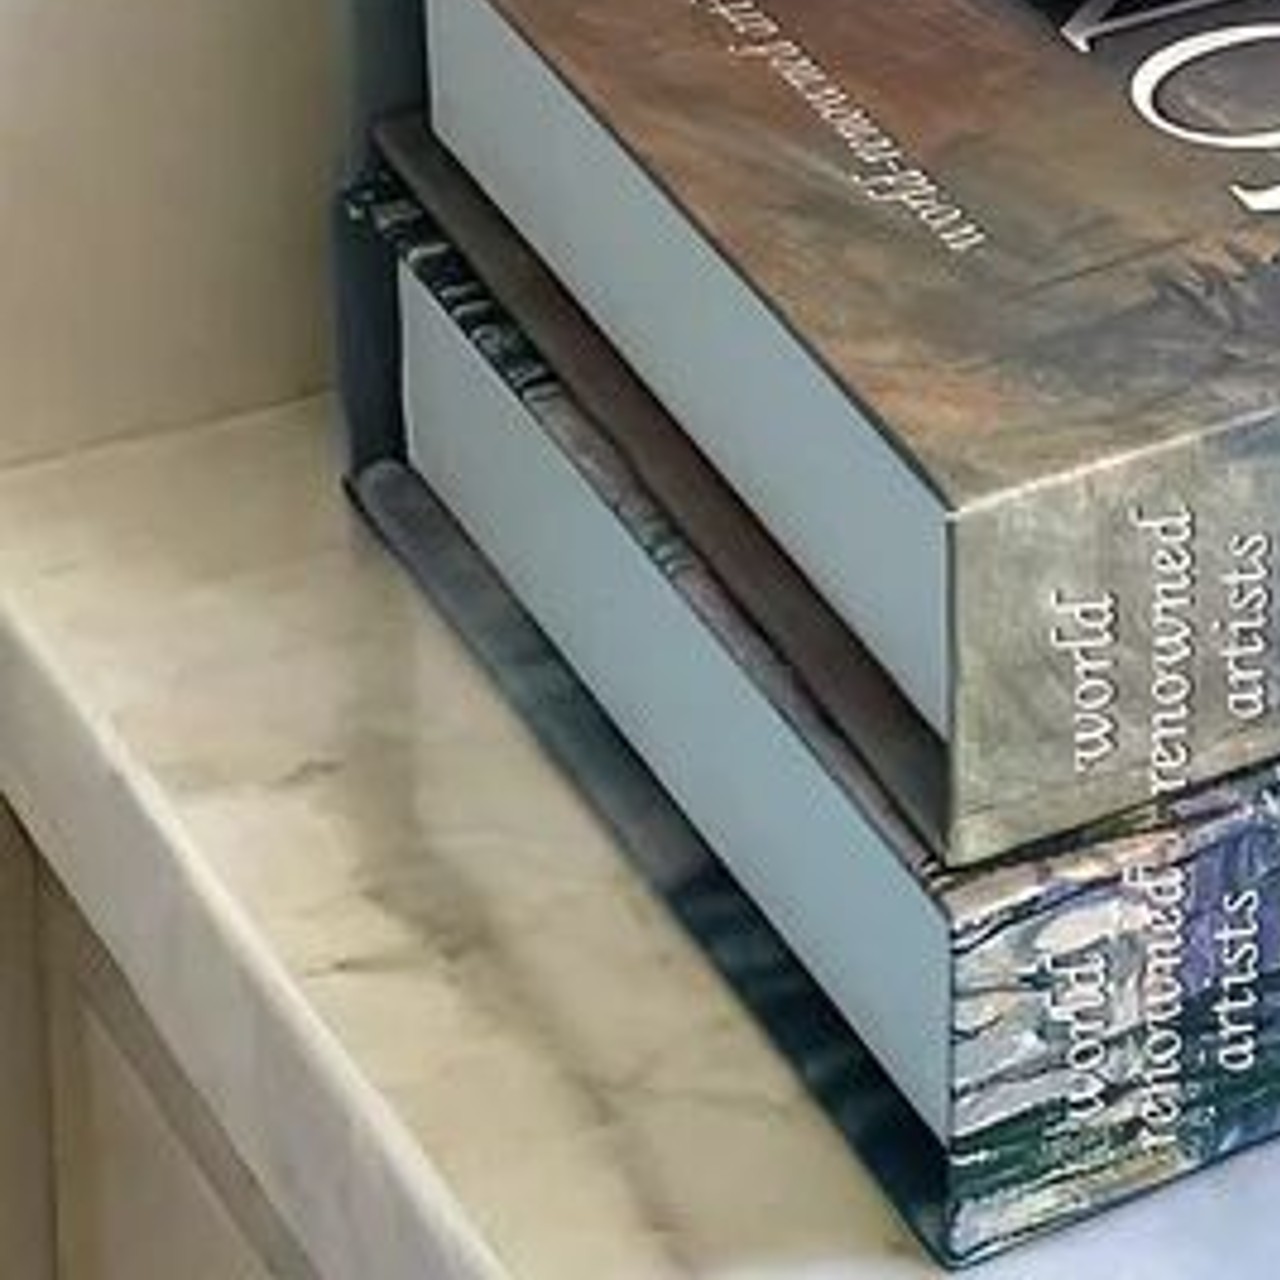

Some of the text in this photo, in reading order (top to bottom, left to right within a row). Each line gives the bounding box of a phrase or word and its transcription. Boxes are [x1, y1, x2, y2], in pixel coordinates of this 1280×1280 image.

[1051, 587, 1119, 773] world
[1127, 503, 1193, 797] renowned
[1211, 532, 1272, 722] artists
[1205, 890, 1260, 1074] artists
